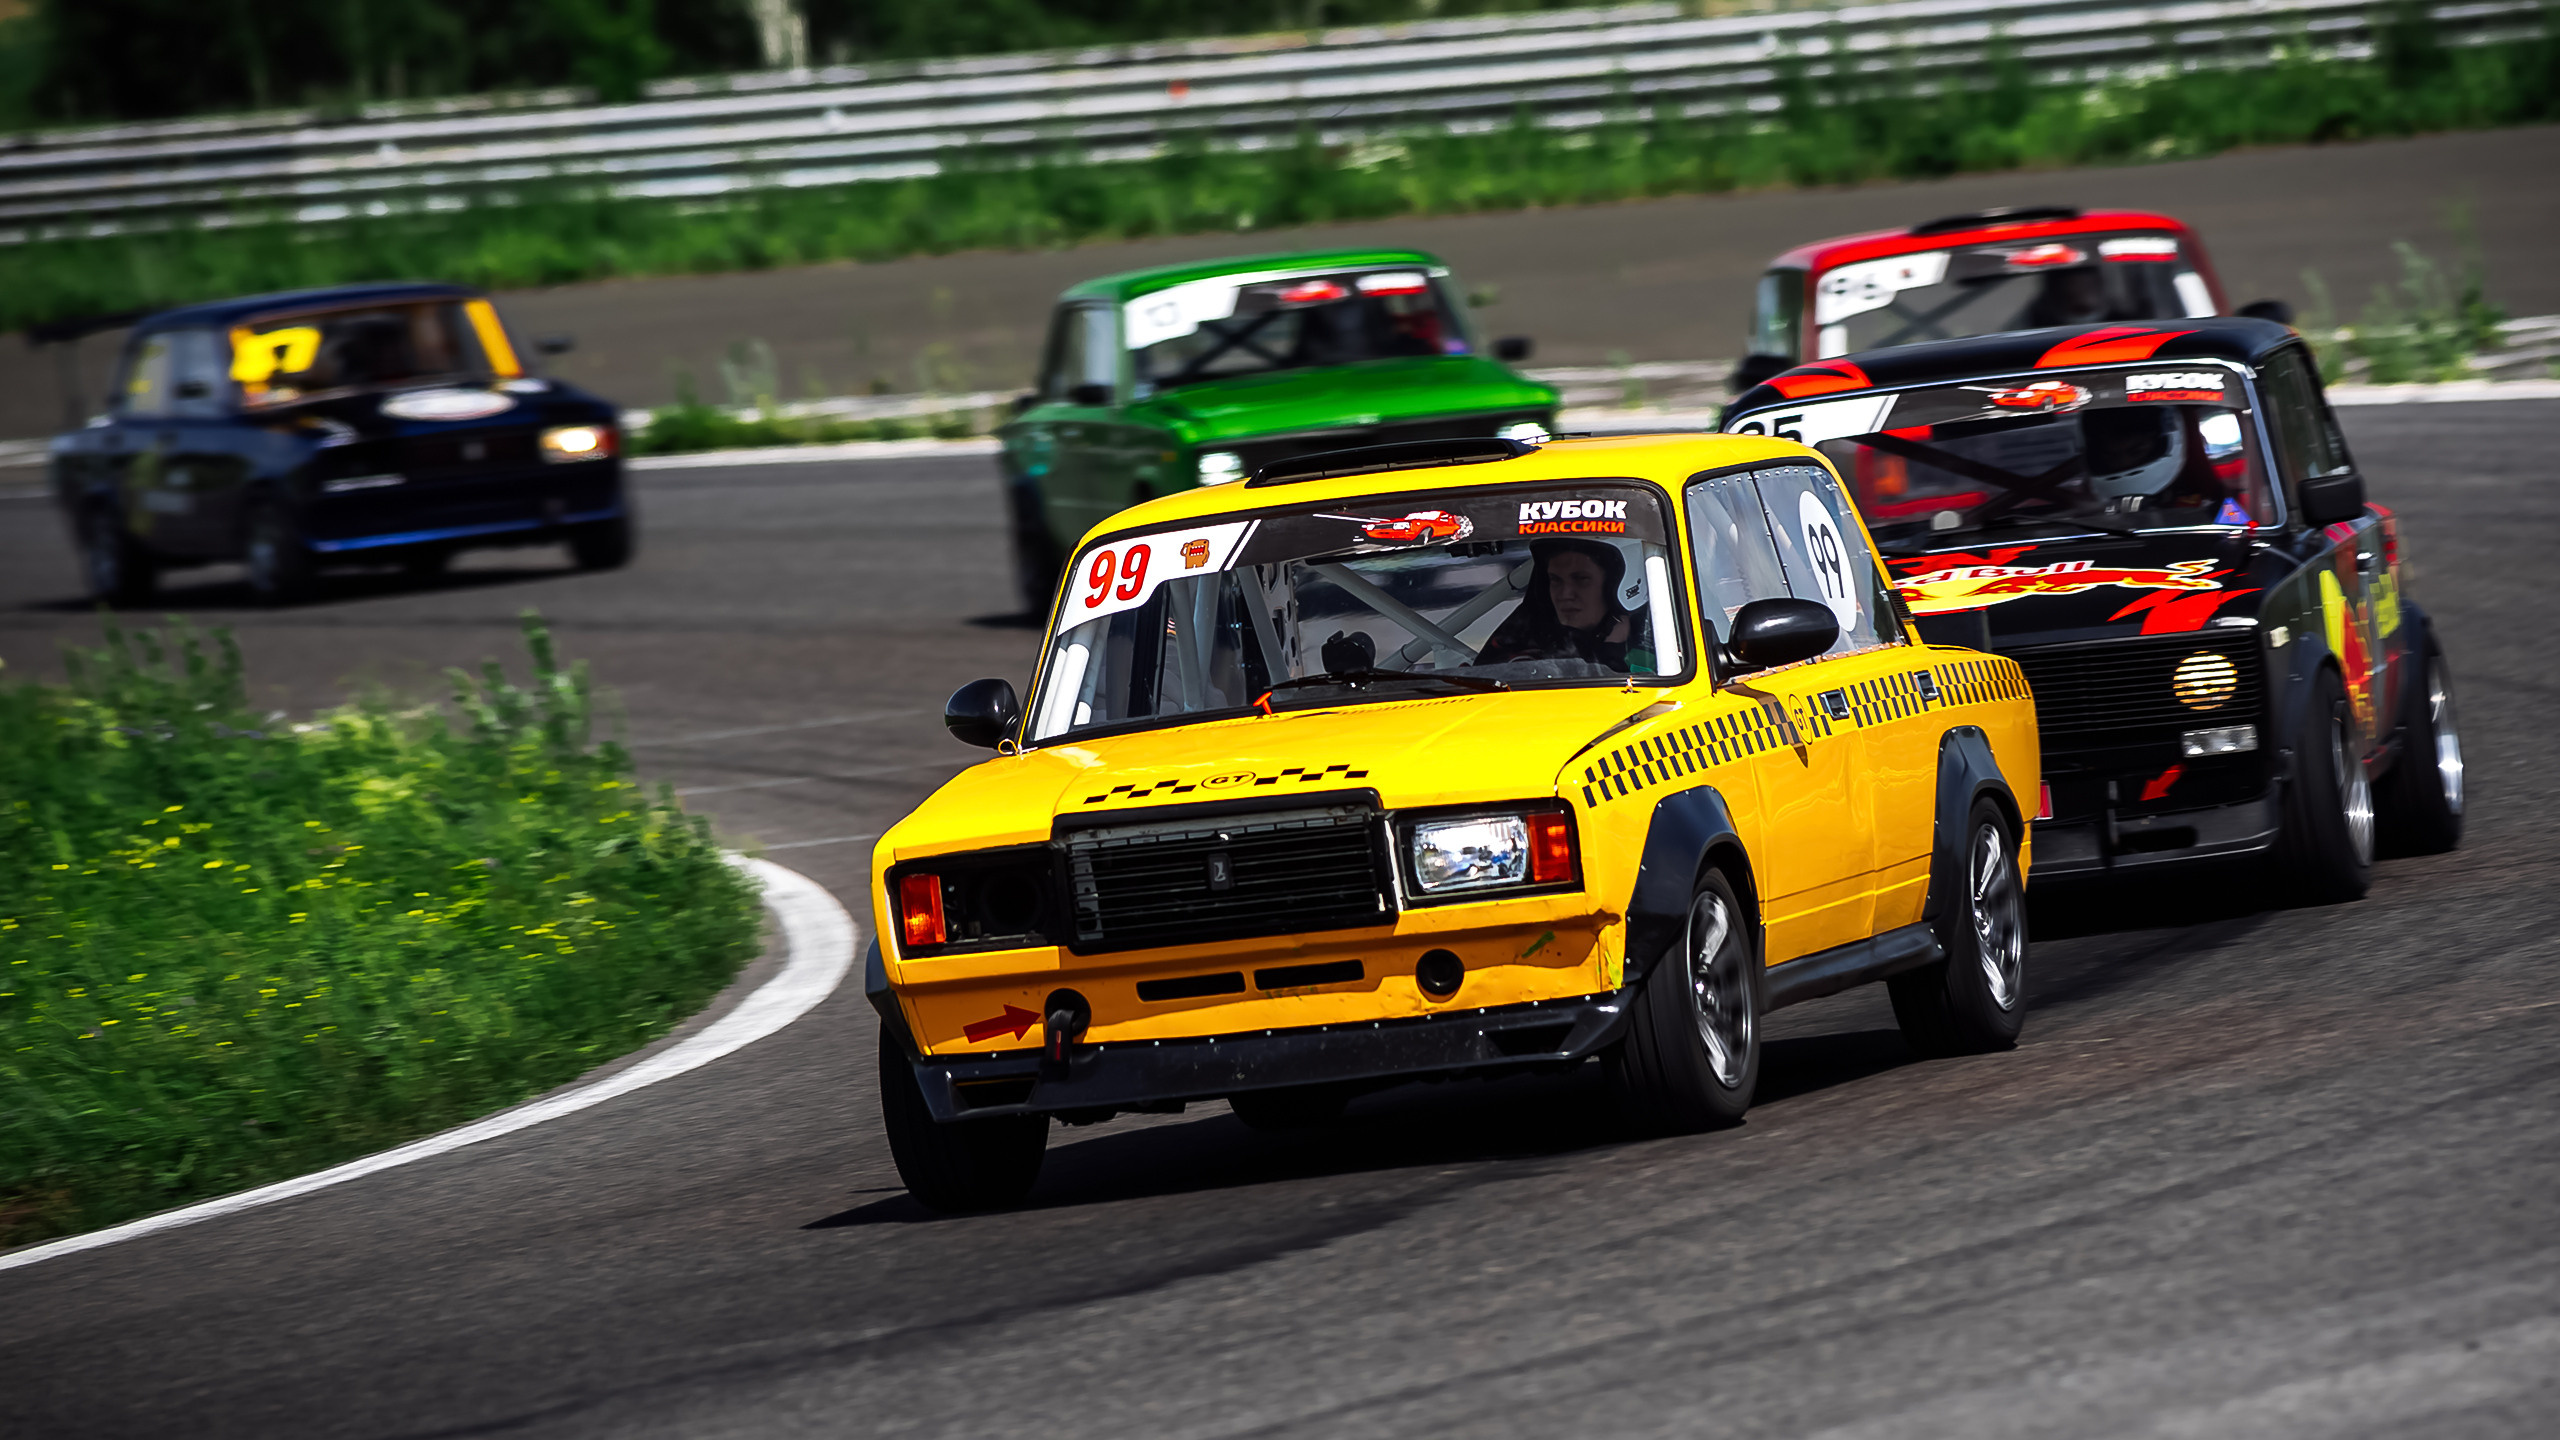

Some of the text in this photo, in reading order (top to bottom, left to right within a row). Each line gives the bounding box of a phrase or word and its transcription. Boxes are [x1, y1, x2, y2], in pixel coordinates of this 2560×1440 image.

[1518, 500, 1628, 520] КУБОК
[1518, 520, 1626, 534] КЛАССИКИ
[1808, 523, 1845, 599] 99
[1968, 561, 2087, 579] Bull
[1084, 543, 1152, 609] 99
[1794, 708, 1808, 730] GT
[1210, 774, 1250, 784] GT
